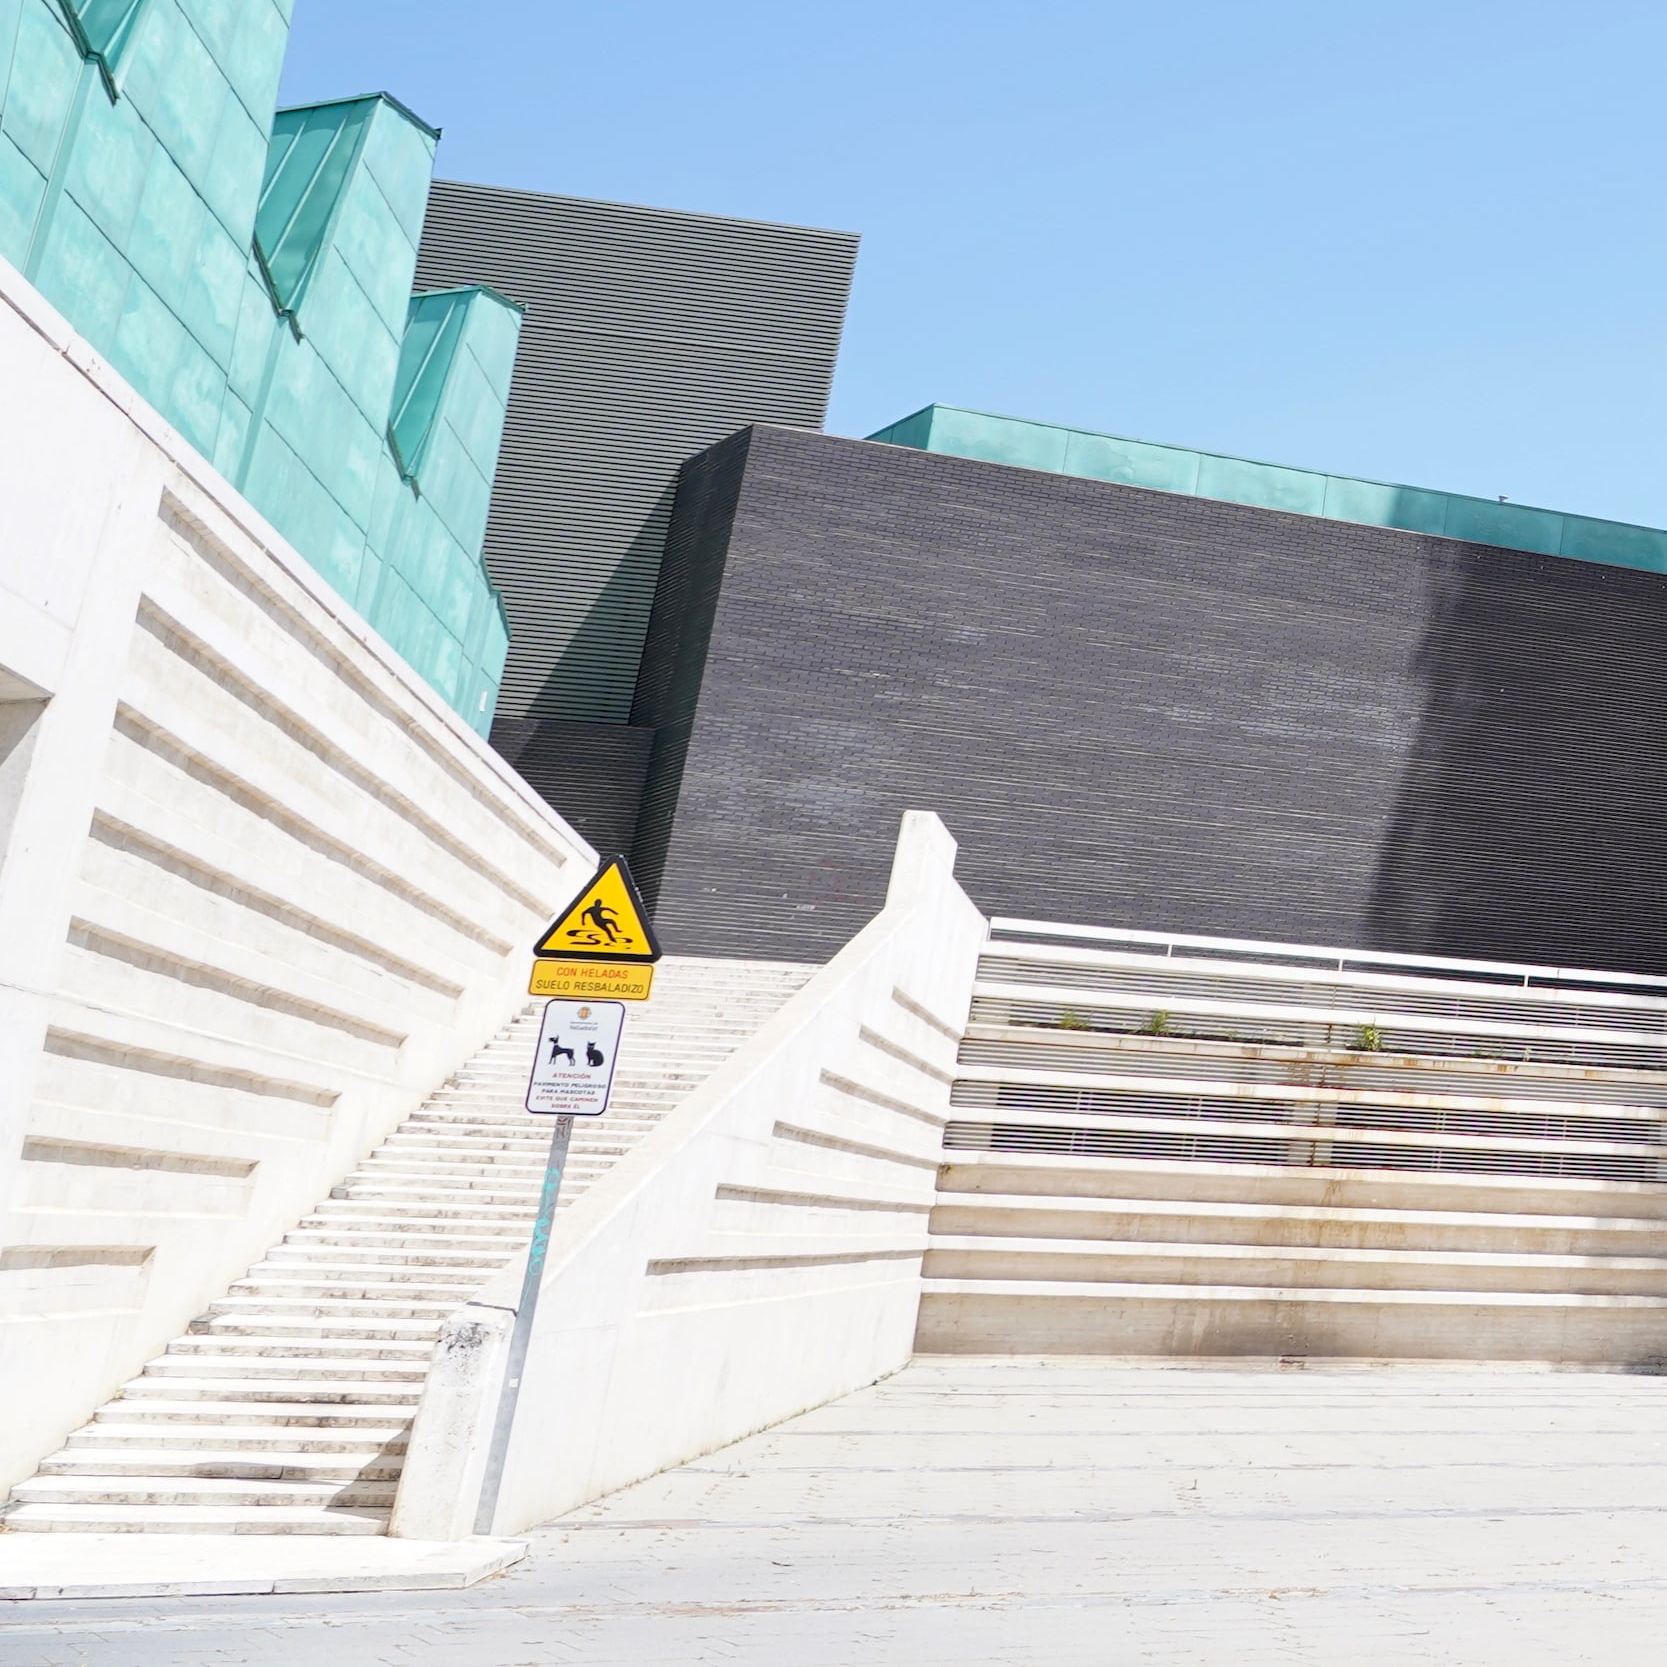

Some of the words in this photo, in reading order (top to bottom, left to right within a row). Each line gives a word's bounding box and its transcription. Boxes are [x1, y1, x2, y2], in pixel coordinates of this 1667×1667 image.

[556, 967, 578, 977] CON
[580, 968, 629, 979] HELADAS
[536, 979, 570, 990] SUELO
[573, 981, 644, 994] RESBALADIZO
